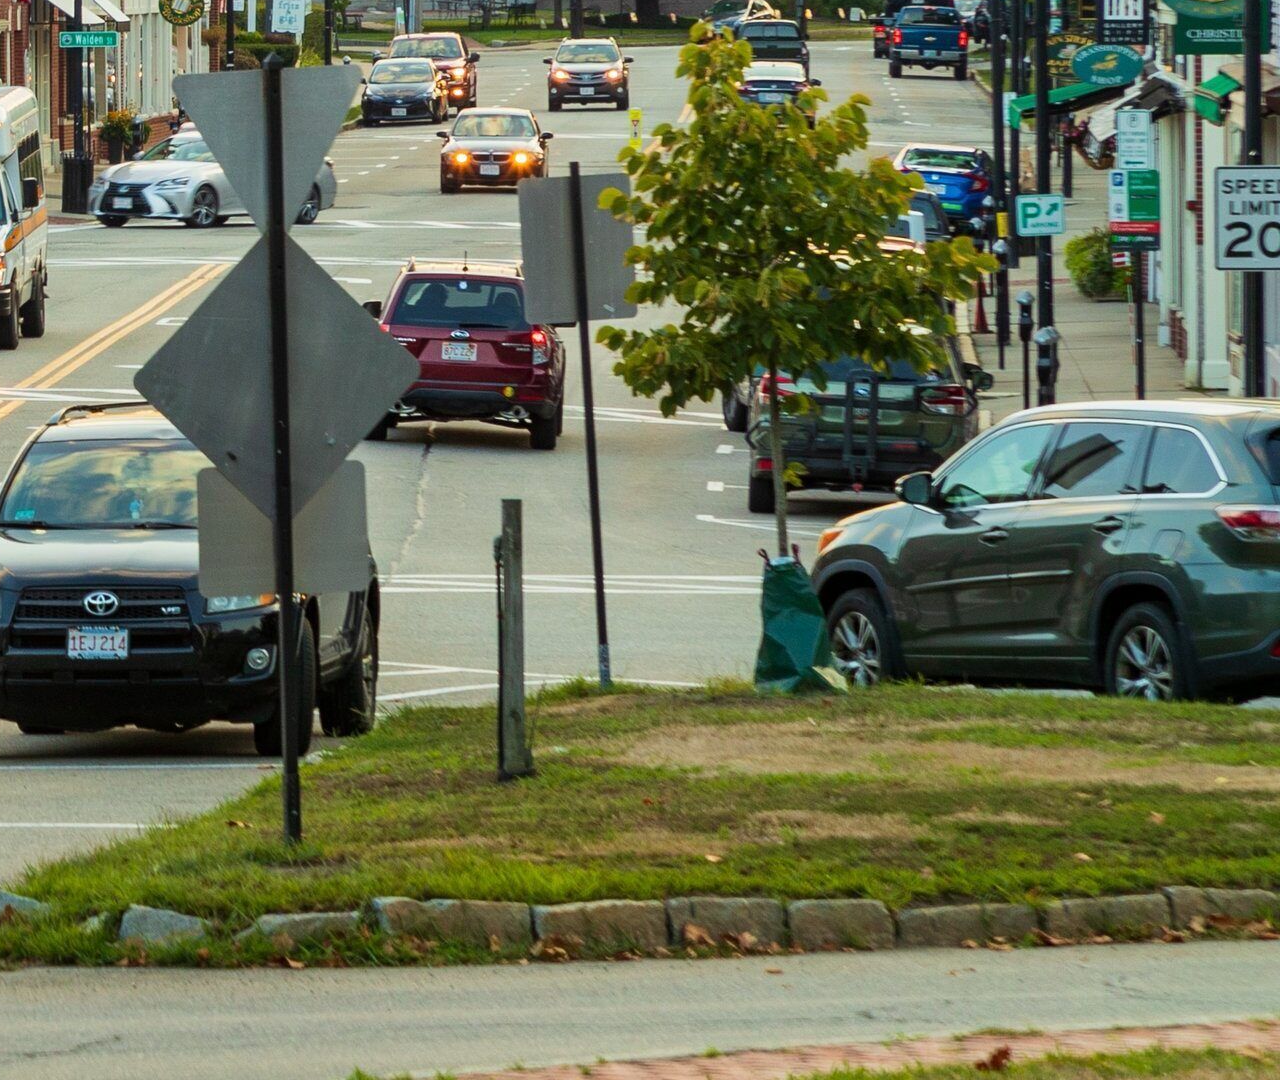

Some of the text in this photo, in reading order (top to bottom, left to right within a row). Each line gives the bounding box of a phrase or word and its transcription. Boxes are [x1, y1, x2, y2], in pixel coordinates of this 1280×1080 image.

[75, 34, 103, 45] Walden
[1186, 29, 1244, 38] CHRISTI
[1222, 179, 1280, 194] SPEE
[1224, 221, 1280, 258] 20
[70, 636, 126, 651] 1EJ 214
